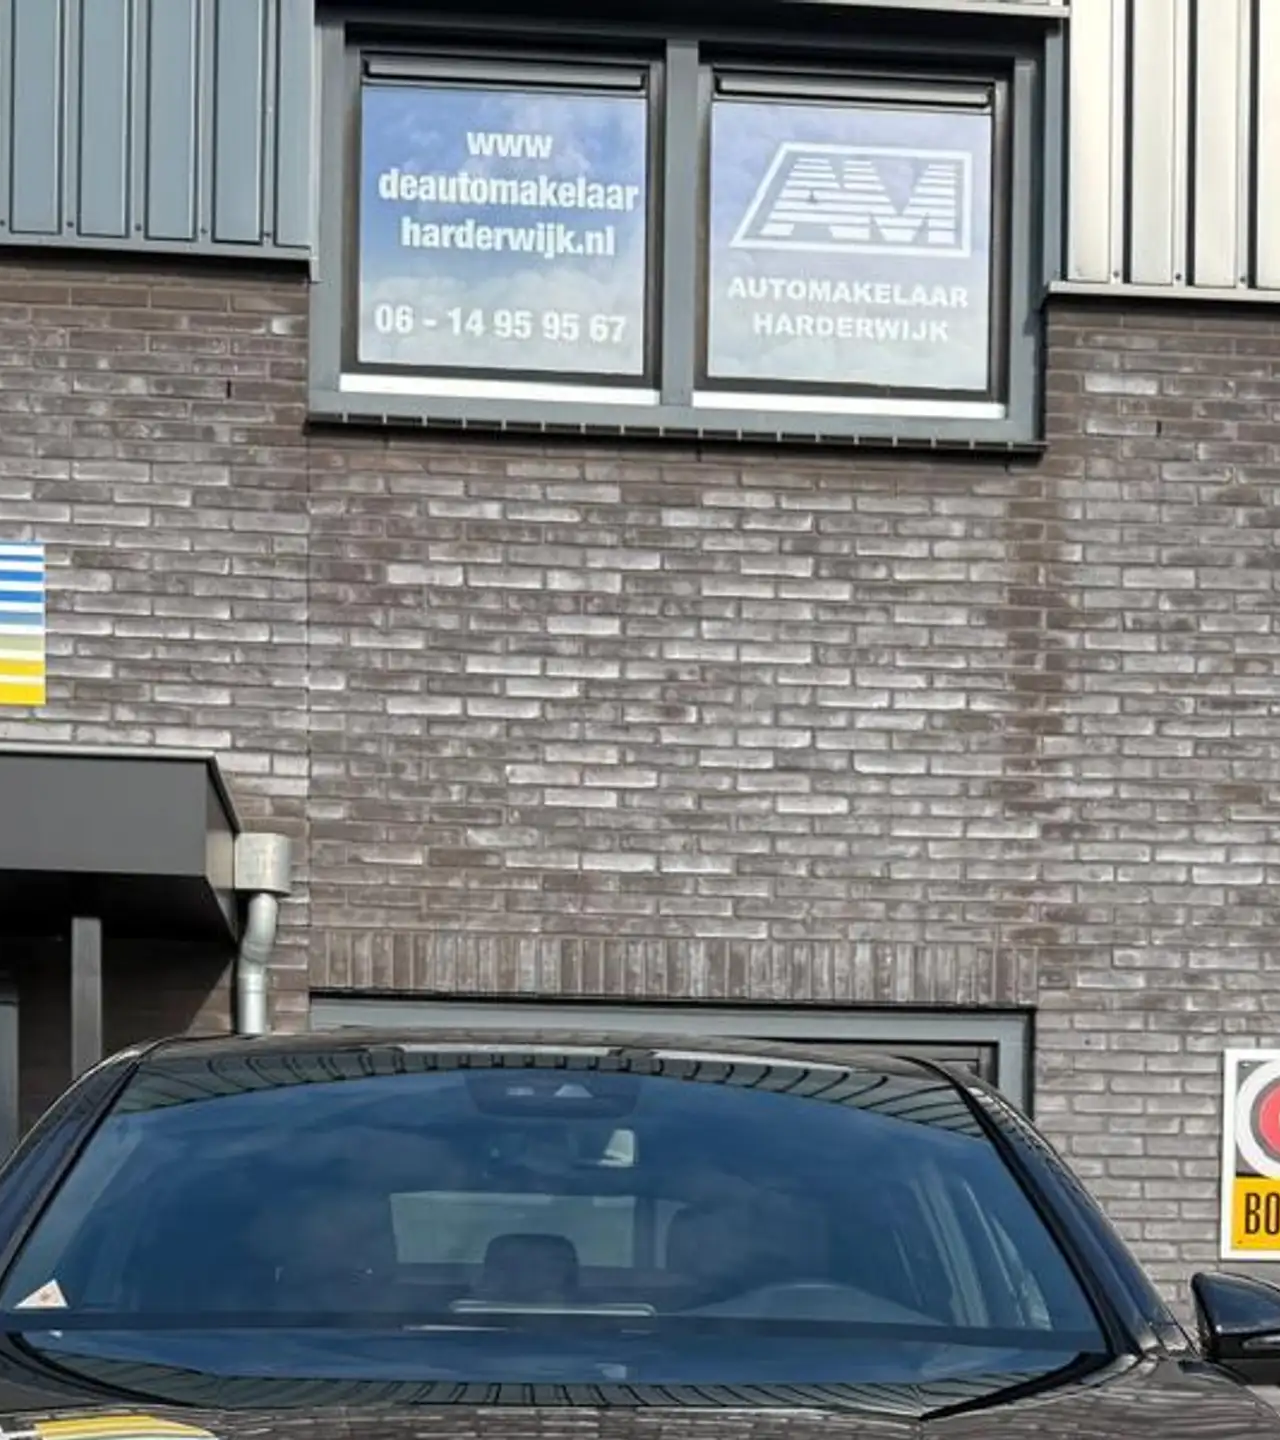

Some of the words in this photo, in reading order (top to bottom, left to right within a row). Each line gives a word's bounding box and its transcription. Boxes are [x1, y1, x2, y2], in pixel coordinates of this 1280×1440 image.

[466, 132, 552, 158] www
[378, 169, 639, 214] deautomakelaar
[401, 218, 615, 259] harderwijk.nl
[727, 276, 969, 309] AUTOMAKELAAR
[374, 303, 410, 335] 06
[447, 307, 484, 338] 14
[492, 308, 532, 340] 95
[541, 310, 581, 342] 95
[589, 314, 627, 344] 67
[752, 312, 949, 343] HARDERWIJK
